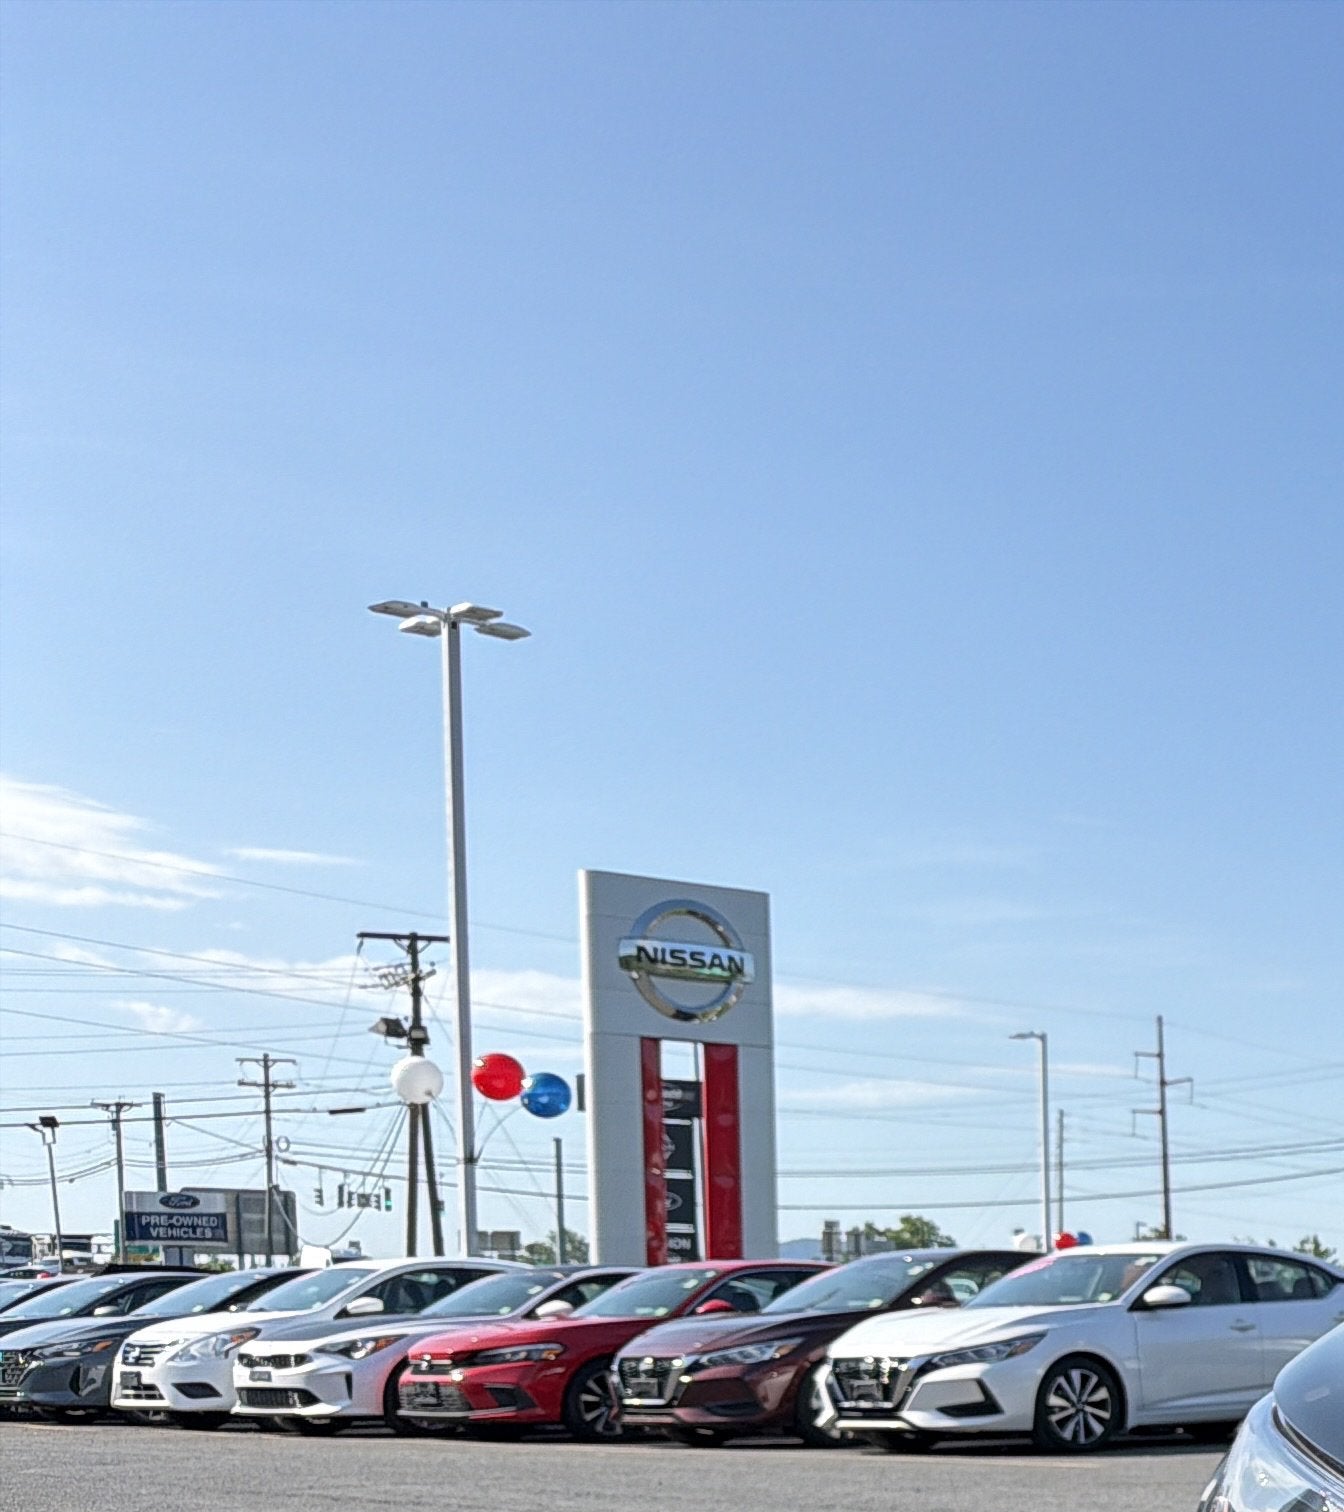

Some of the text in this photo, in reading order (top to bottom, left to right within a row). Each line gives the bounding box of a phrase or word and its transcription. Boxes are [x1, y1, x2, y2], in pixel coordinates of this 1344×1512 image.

[636, 946, 744, 975] NISSAN
[142, 1215, 218, 1227] PRE-OWNED
[150, 1227, 213, 1239] VEHICLES
